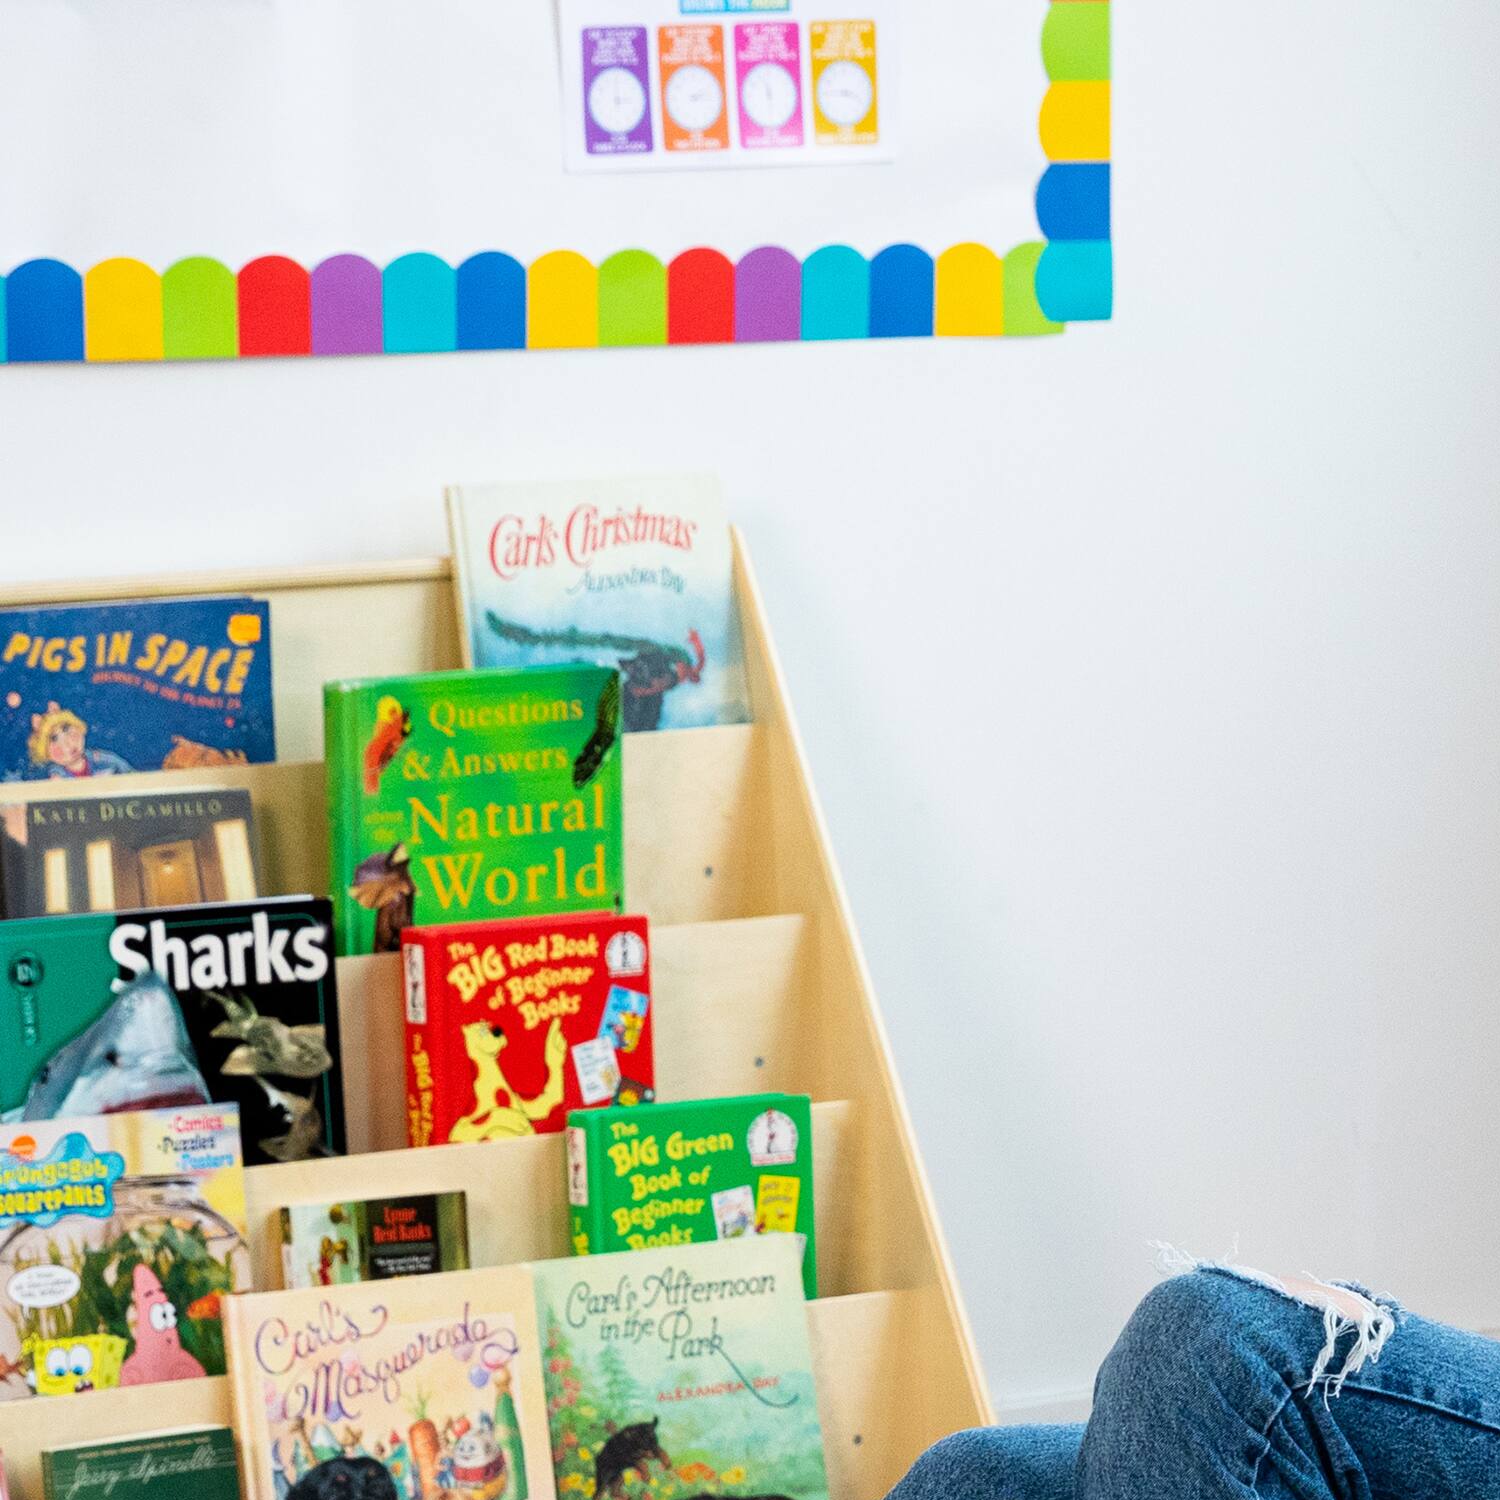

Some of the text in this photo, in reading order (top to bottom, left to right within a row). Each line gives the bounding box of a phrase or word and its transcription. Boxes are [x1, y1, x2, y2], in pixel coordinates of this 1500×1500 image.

[564, 502, 697, 568] Christmas
[3, 632, 87, 673] PIGS
[95, 630, 134, 667] IN
[134, 632, 255, 695] SPACE
[428, 692, 584, 737] Questions
[402, 745, 569, 781] & Answers
[407, 783, 605, 845] Natural
[421, 843, 607, 911] World
[109, 911, 329, 994] Sharks
[446, 945, 506, 1003] BIG
[505, 935, 548, 969] Red
[549, 932, 599, 960] Book
[447, 940, 477, 961] The
[504, 966, 595, 1005] Beginner
[517, 990, 582, 1031] Books
[607, 1135, 660, 1177] BIG
[665, 1130, 735, 1160] Green
[610, 1121, 639, 1140] The
[629, 1164, 712, 1201] Book of
[611, 1198, 705, 1237] Beginner
[626, 1223, 693, 1251] Books
[565, 1266, 776, 1329] Carl's Afternoon
[255, 1300, 388, 1376] Carl's
[600, 1308, 724, 1360] in the Park
[281, 1301, 519, 1421] Masquerade
